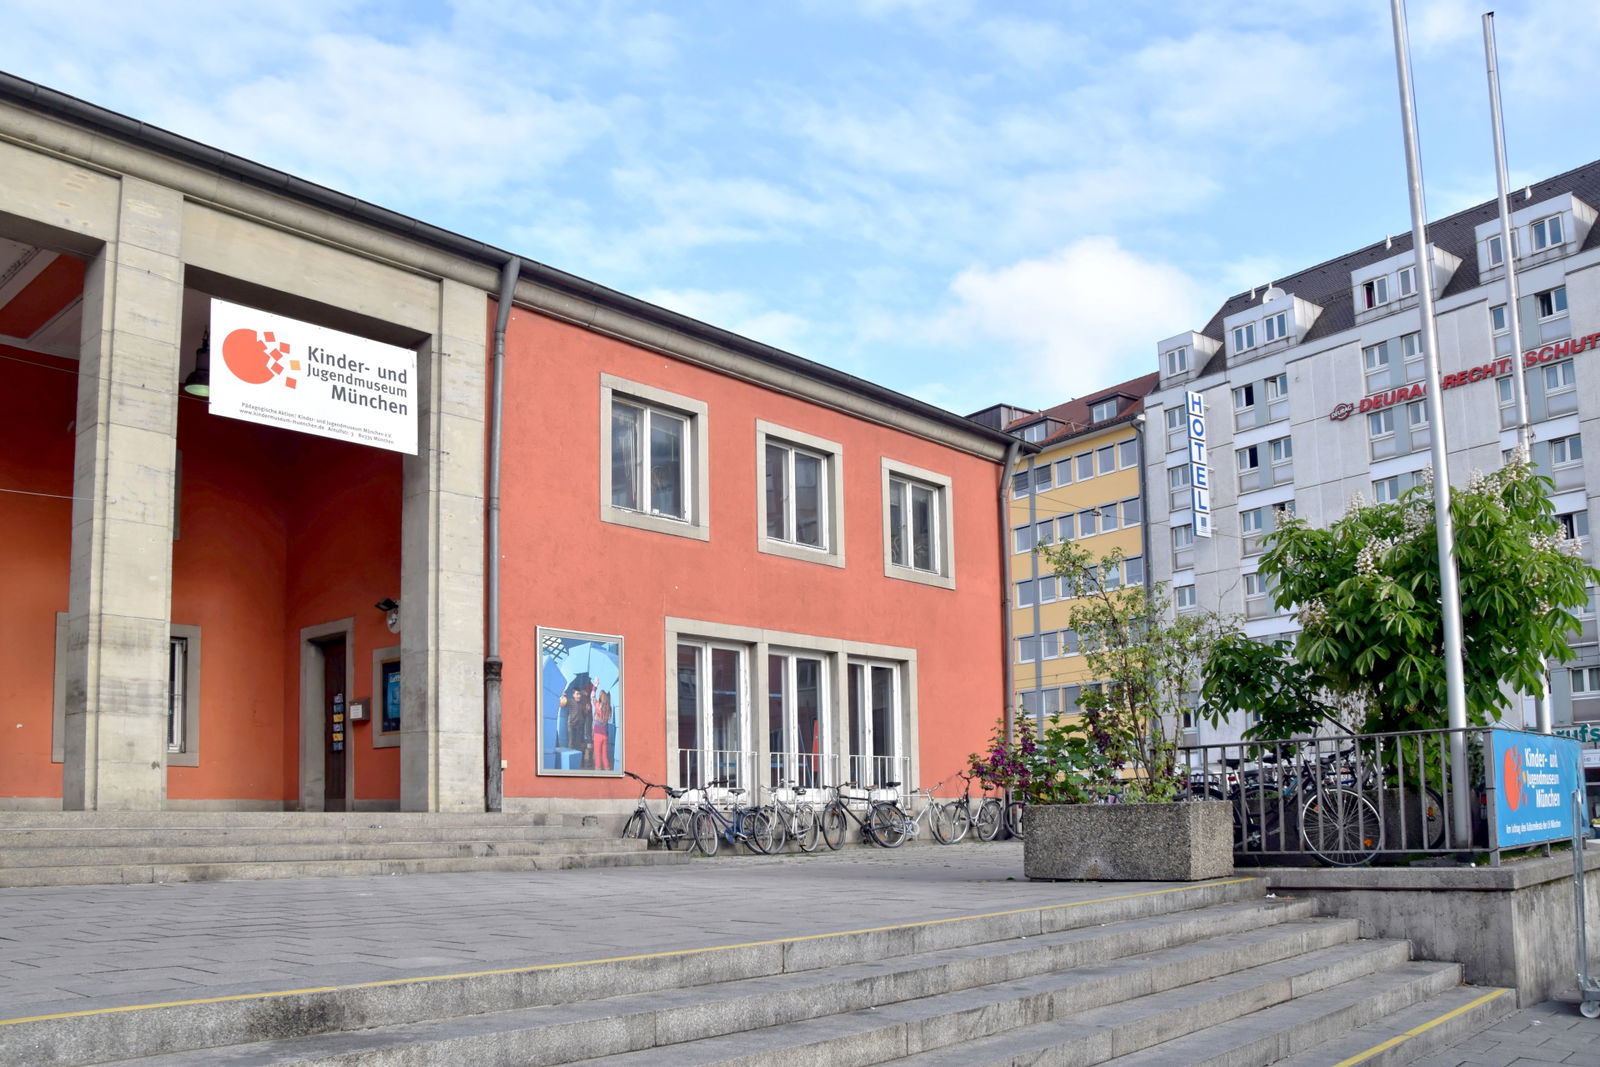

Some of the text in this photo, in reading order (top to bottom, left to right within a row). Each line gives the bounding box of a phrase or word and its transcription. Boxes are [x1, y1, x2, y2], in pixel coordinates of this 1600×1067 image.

[307, 363, 407, 398] Jugendmuseum
[308, 346, 407, 384] Kinder- und
[332, 384, 408, 415] München
[1191, 393, 1208, 511] HOTEL
[1525, 747, 1558, 768] Kinder- und
[1535, 788, 1561, 808] München
